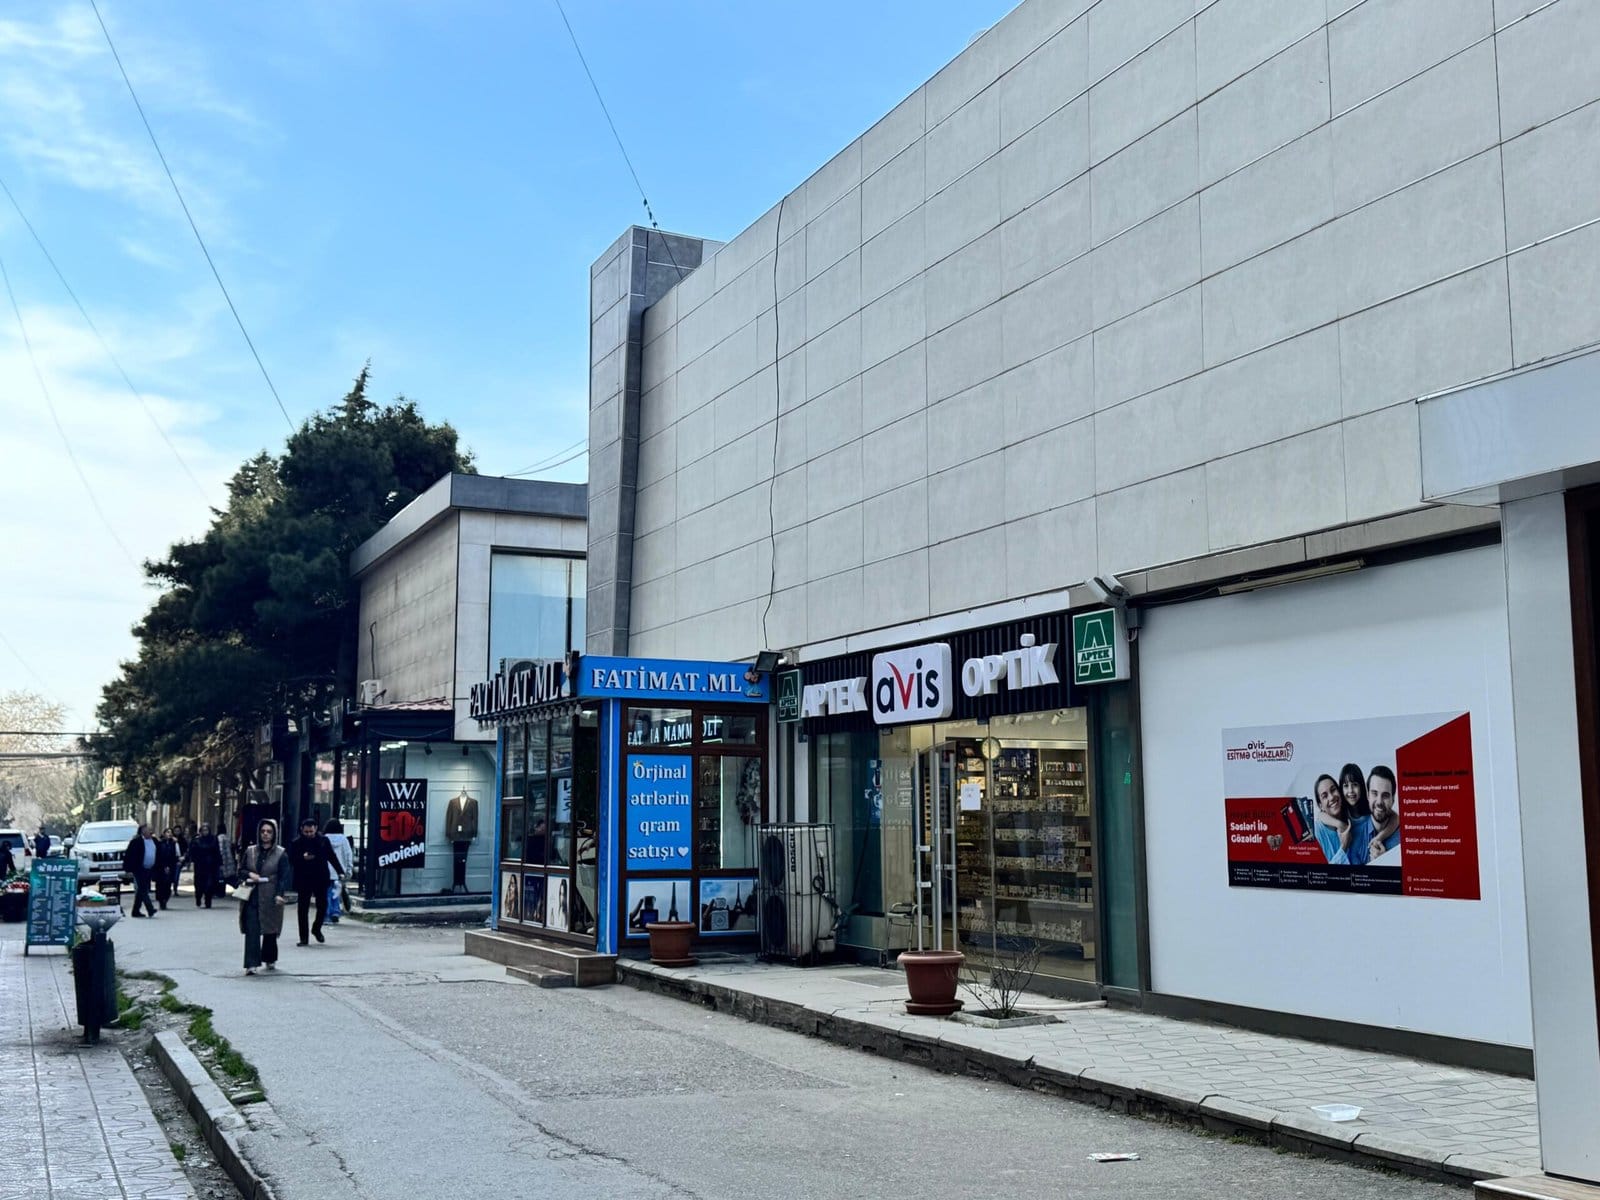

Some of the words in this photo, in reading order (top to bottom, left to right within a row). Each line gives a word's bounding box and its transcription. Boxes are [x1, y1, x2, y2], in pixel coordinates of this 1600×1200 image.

[962, 633, 1060, 697] OPTİK
[592, 666, 742, 692] FATİMAT.ML
[876, 658, 940, 714] avis
[800, 677, 869, 718] APTEK
[379, 801, 425, 809] WEMSEY
[630, 790, 689, 806] ətrlərin
[380, 811, 424, 842] 50%
[639, 820, 680, 837] qram
[378, 841, 425, 867] ENDİRİM
[628, 844, 675, 861] satışı
